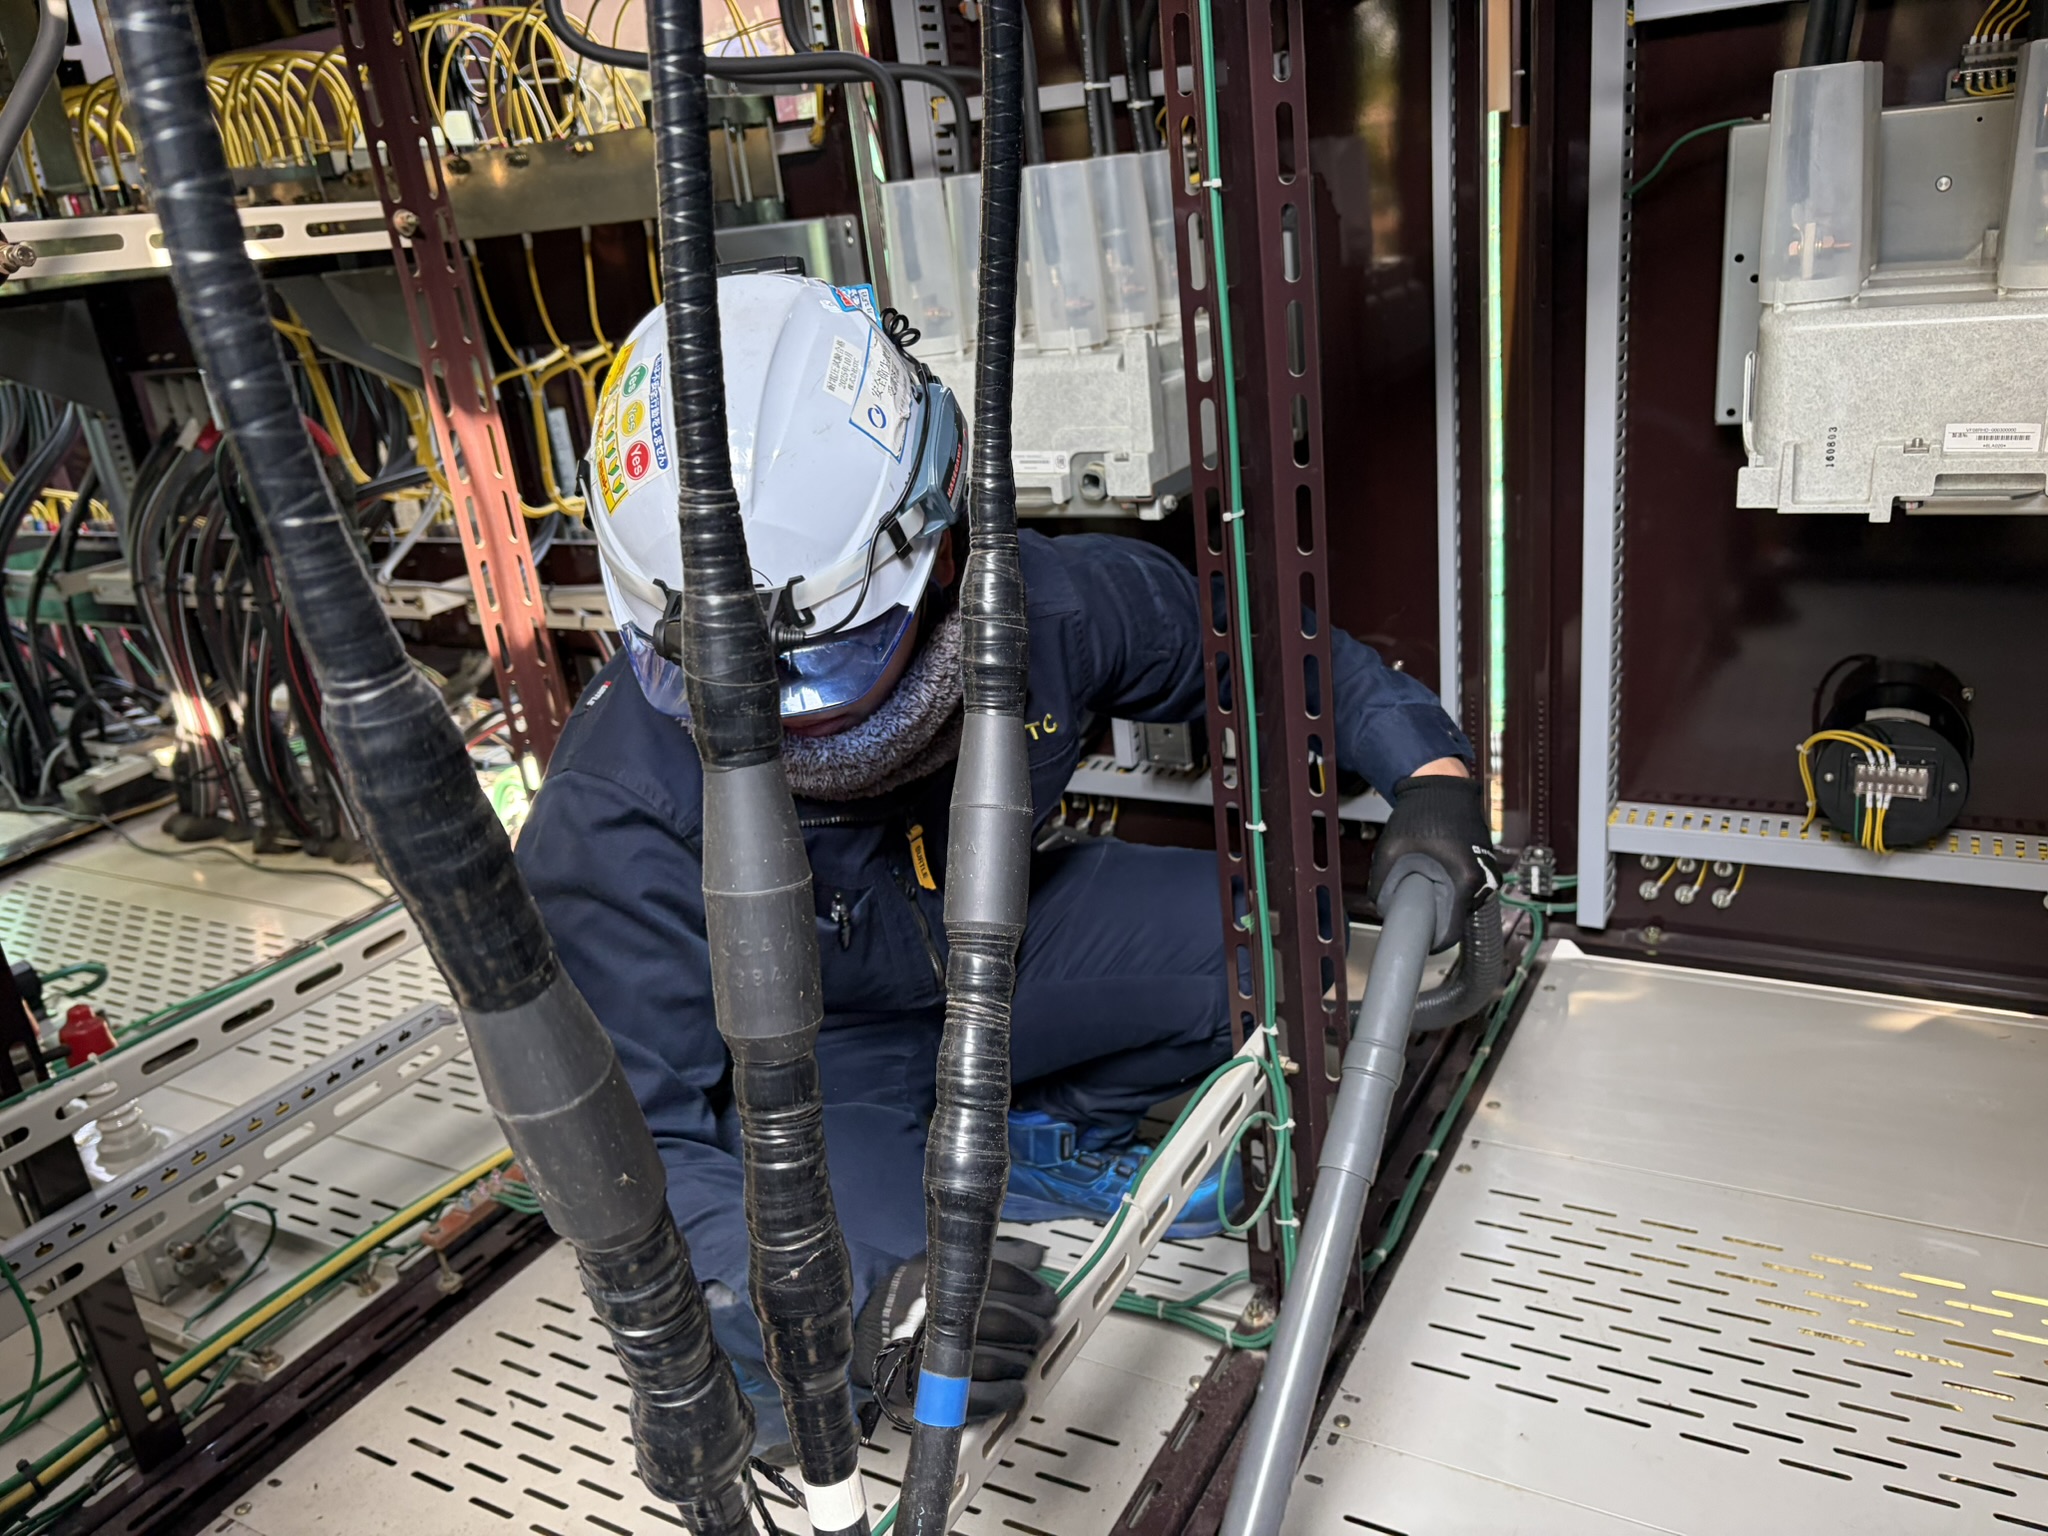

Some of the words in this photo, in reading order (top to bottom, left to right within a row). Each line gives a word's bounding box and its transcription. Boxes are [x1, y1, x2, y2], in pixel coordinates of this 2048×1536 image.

[627, 366, 642, 394] Yes
[626, 402, 639, 433] Yes
[630, 443, 643, 477] Yes
[1825, 426, 1838, 468] 160803
